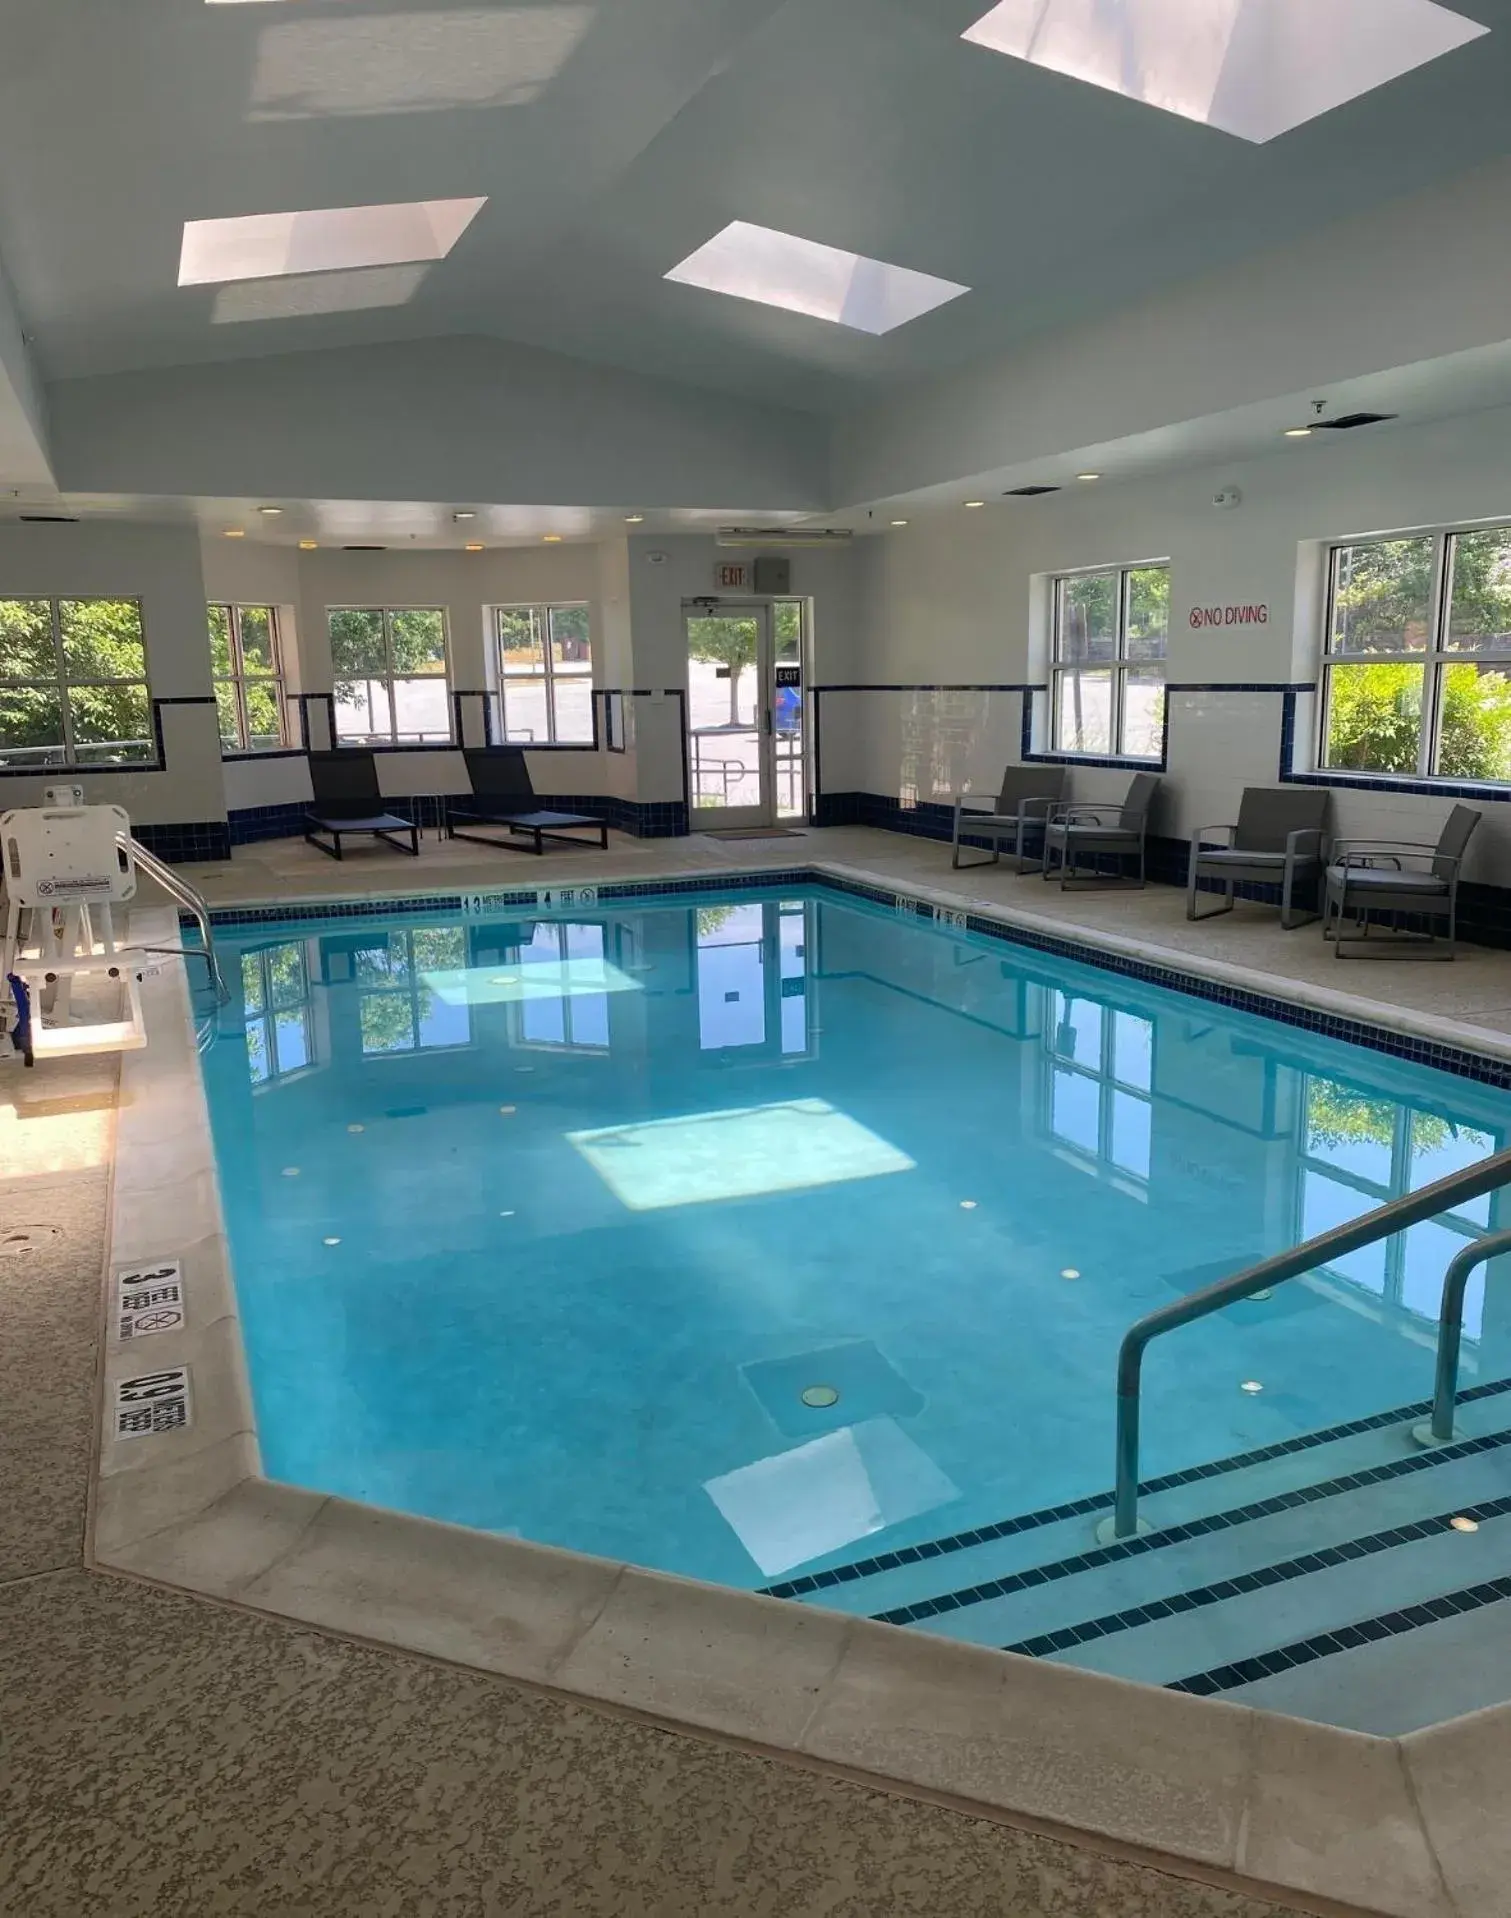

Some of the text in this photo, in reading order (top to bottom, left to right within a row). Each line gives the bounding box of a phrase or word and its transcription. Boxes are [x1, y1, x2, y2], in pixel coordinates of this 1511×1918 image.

[721, 566, 744, 587] EXIT
[1204, 604, 1267, 625] NO DIVING
[778, 669, 798, 681] EXIT
[122, 1268, 177, 1285] 3
[151, 1285, 179, 1302] FEET
